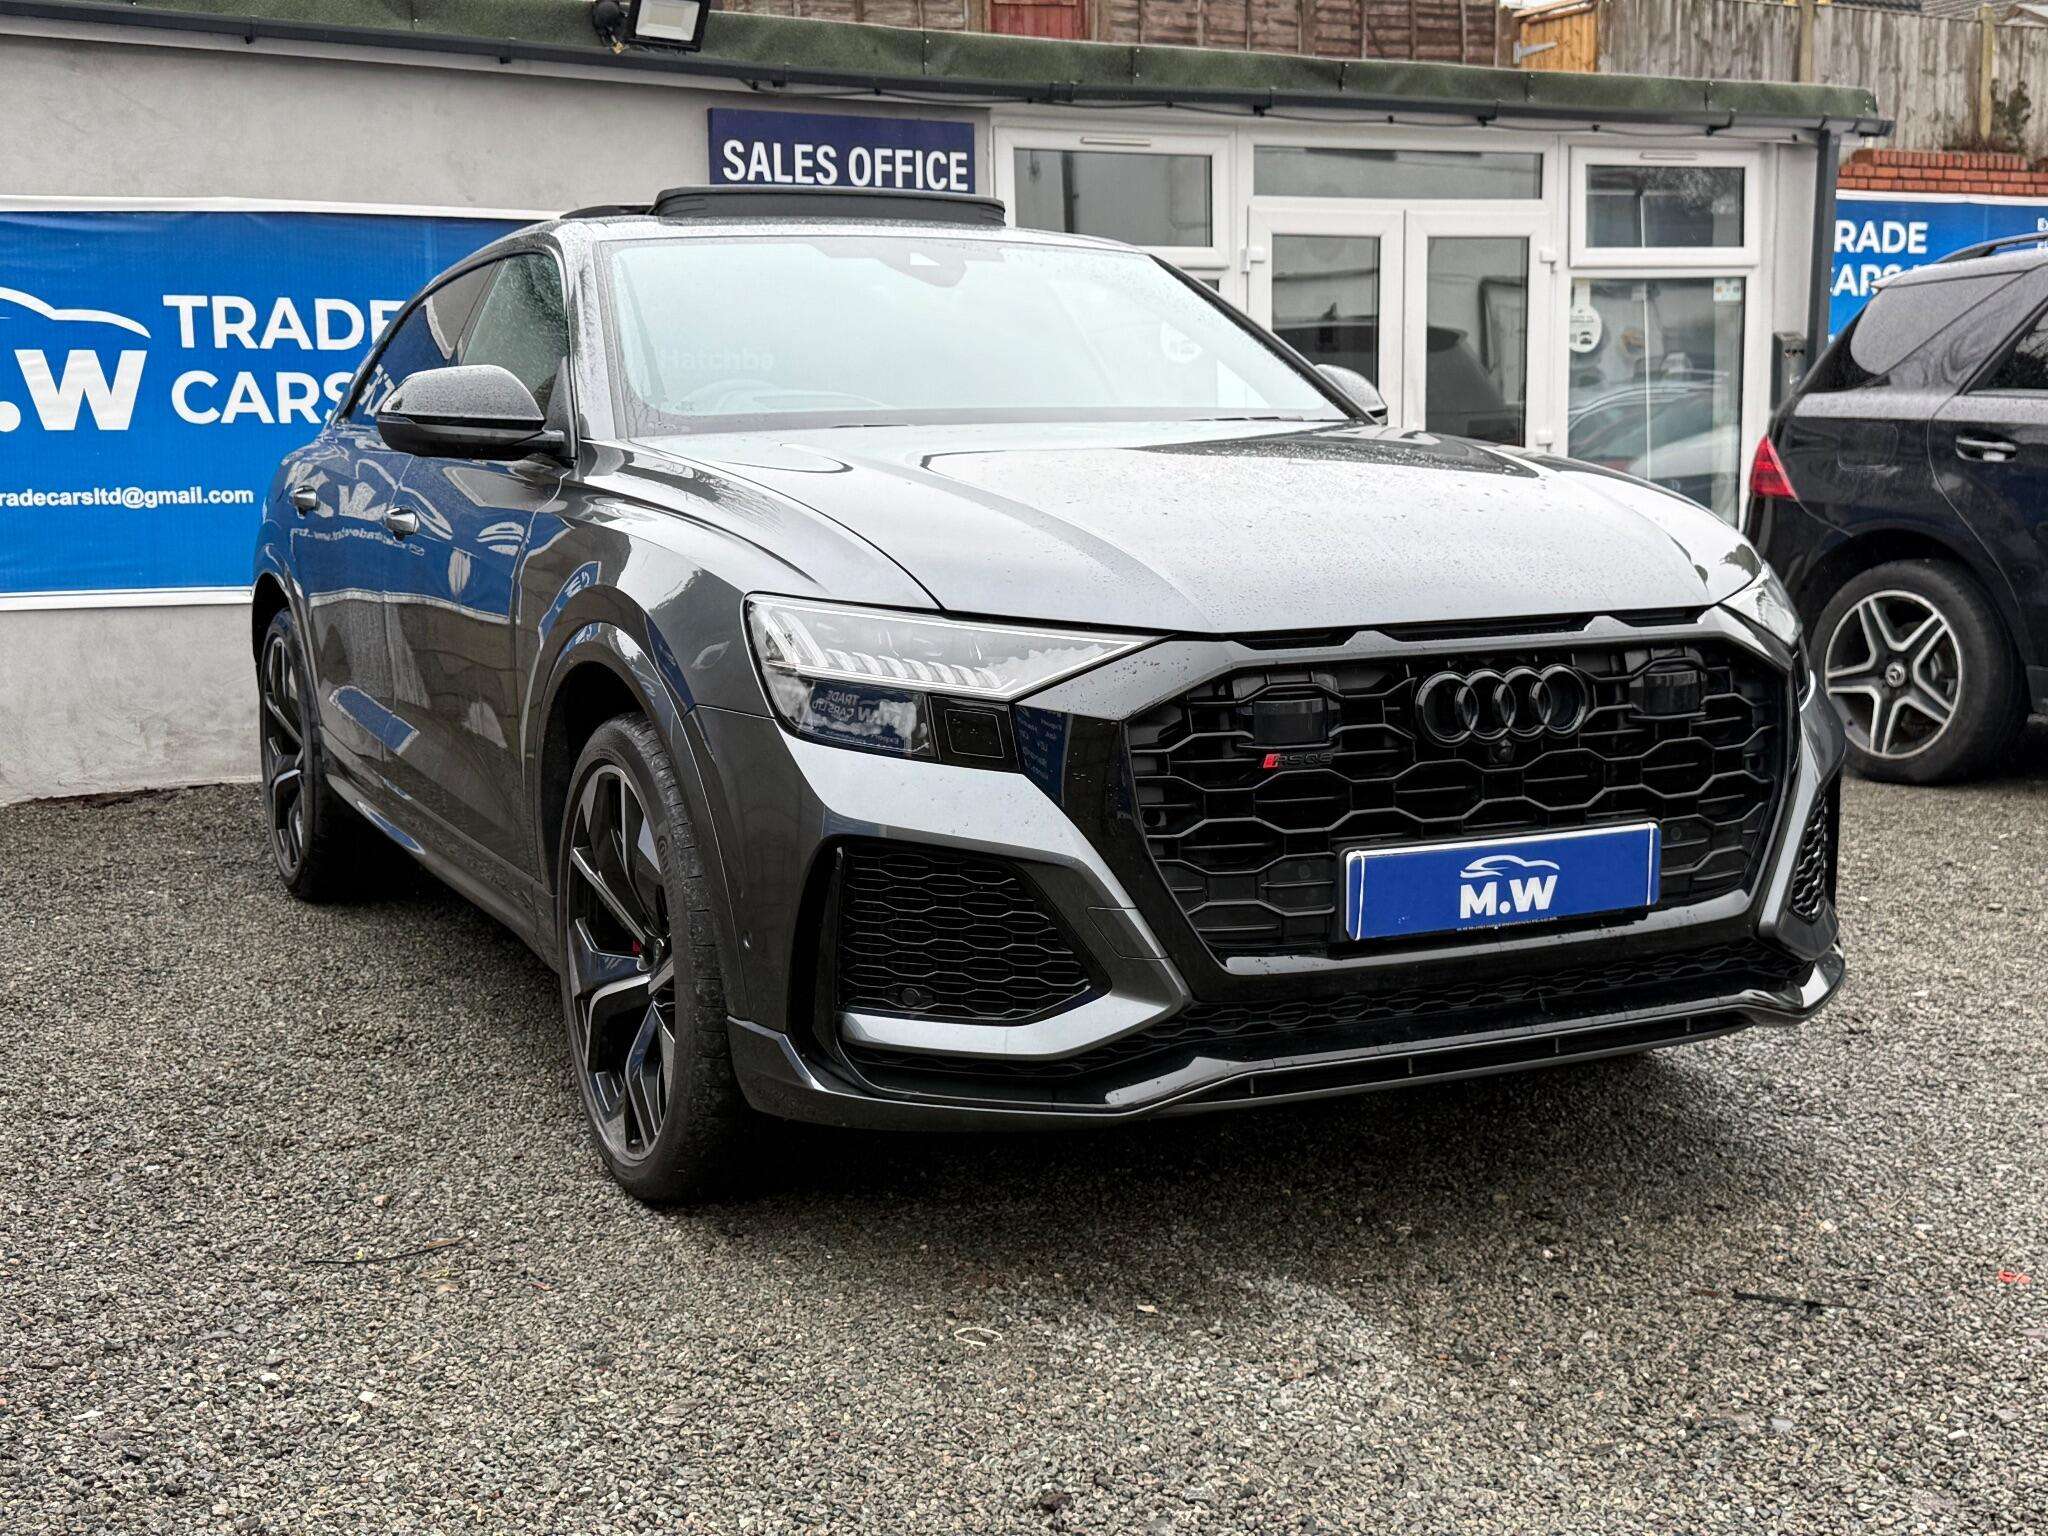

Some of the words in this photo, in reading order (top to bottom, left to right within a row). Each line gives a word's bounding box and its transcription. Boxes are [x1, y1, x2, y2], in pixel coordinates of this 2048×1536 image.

[723, 139, 838, 185] SALES
[848, 146, 968, 191] OFFICE
[1460, 874, 1558, 919] M.W
